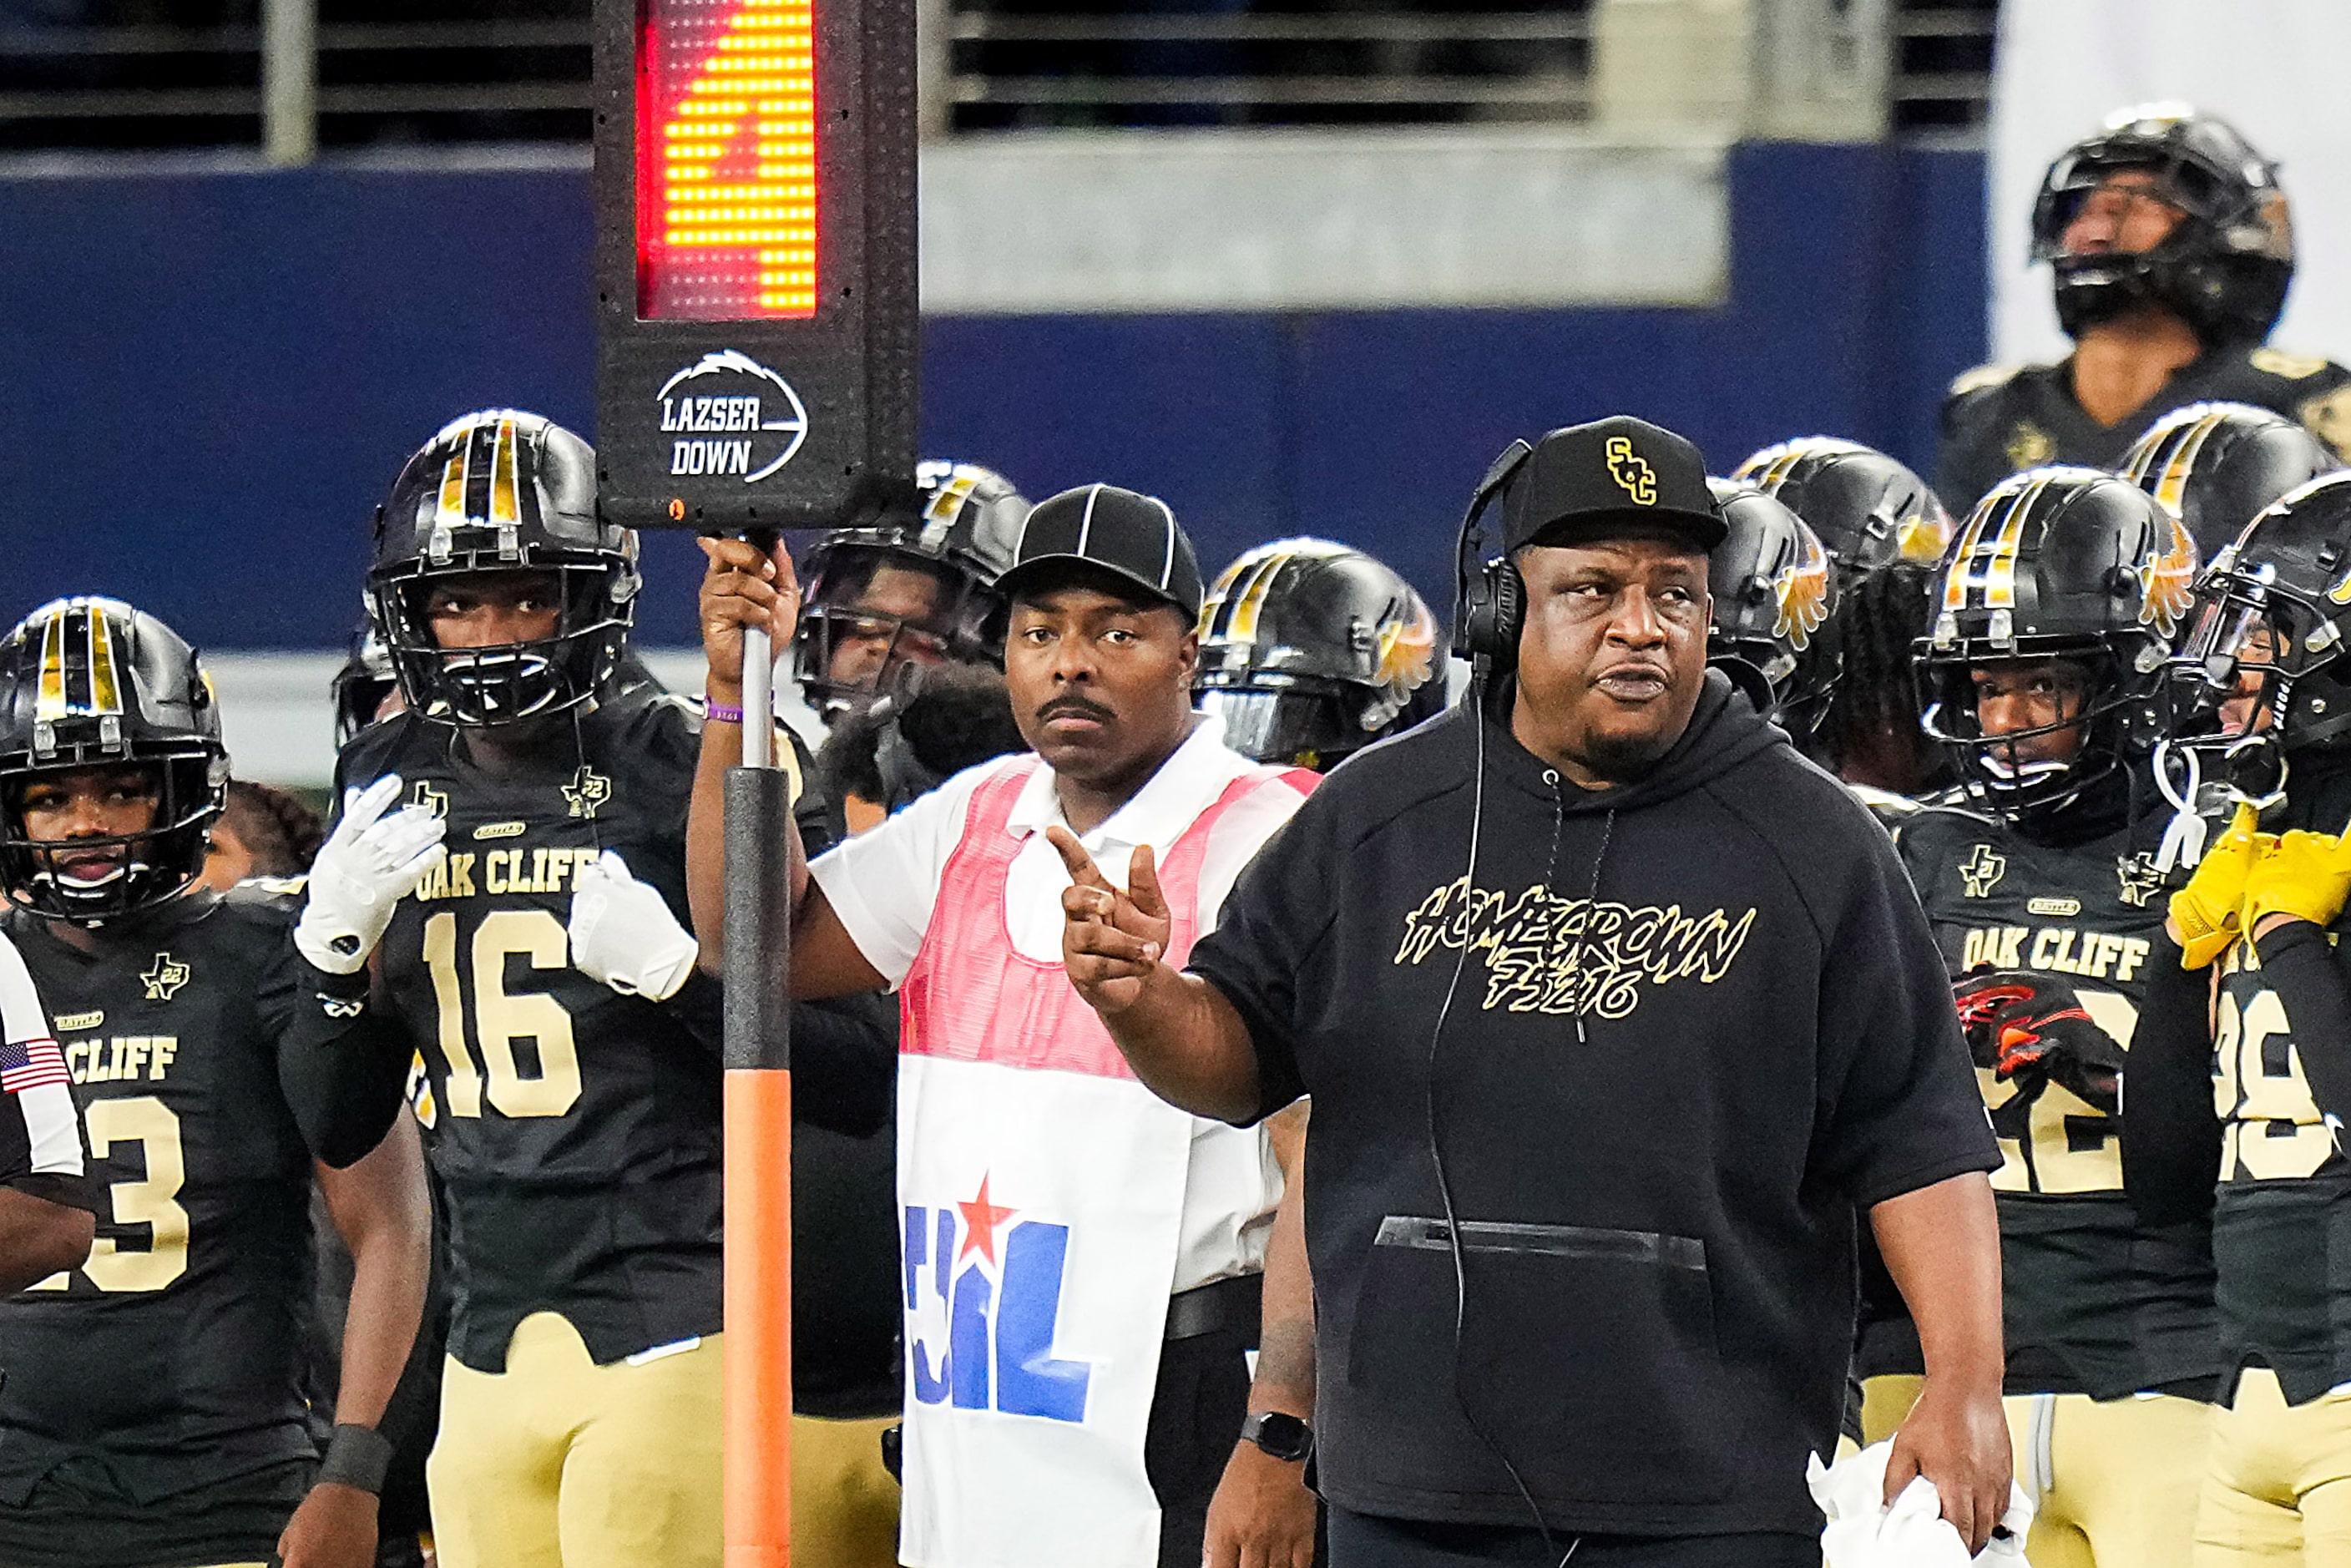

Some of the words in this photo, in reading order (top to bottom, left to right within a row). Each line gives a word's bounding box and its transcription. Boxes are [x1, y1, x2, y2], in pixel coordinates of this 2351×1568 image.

[665, 0, 817, 309] 4
[660, 397, 760, 432] LAZSER
[670, 441, 752, 475] DOWN
[486, 848, 600, 894] CLIFF
[1394, 875, 1757, 984] HOMEGROWN
[1963, 927, 2029, 973] OAK
[2030, 928, 2151, 982] CLIFF
[159, 967, 183, 985] 22
[423, 910, 583, 1119] 16
[65, 1035, 178, 1085] CLIFF
